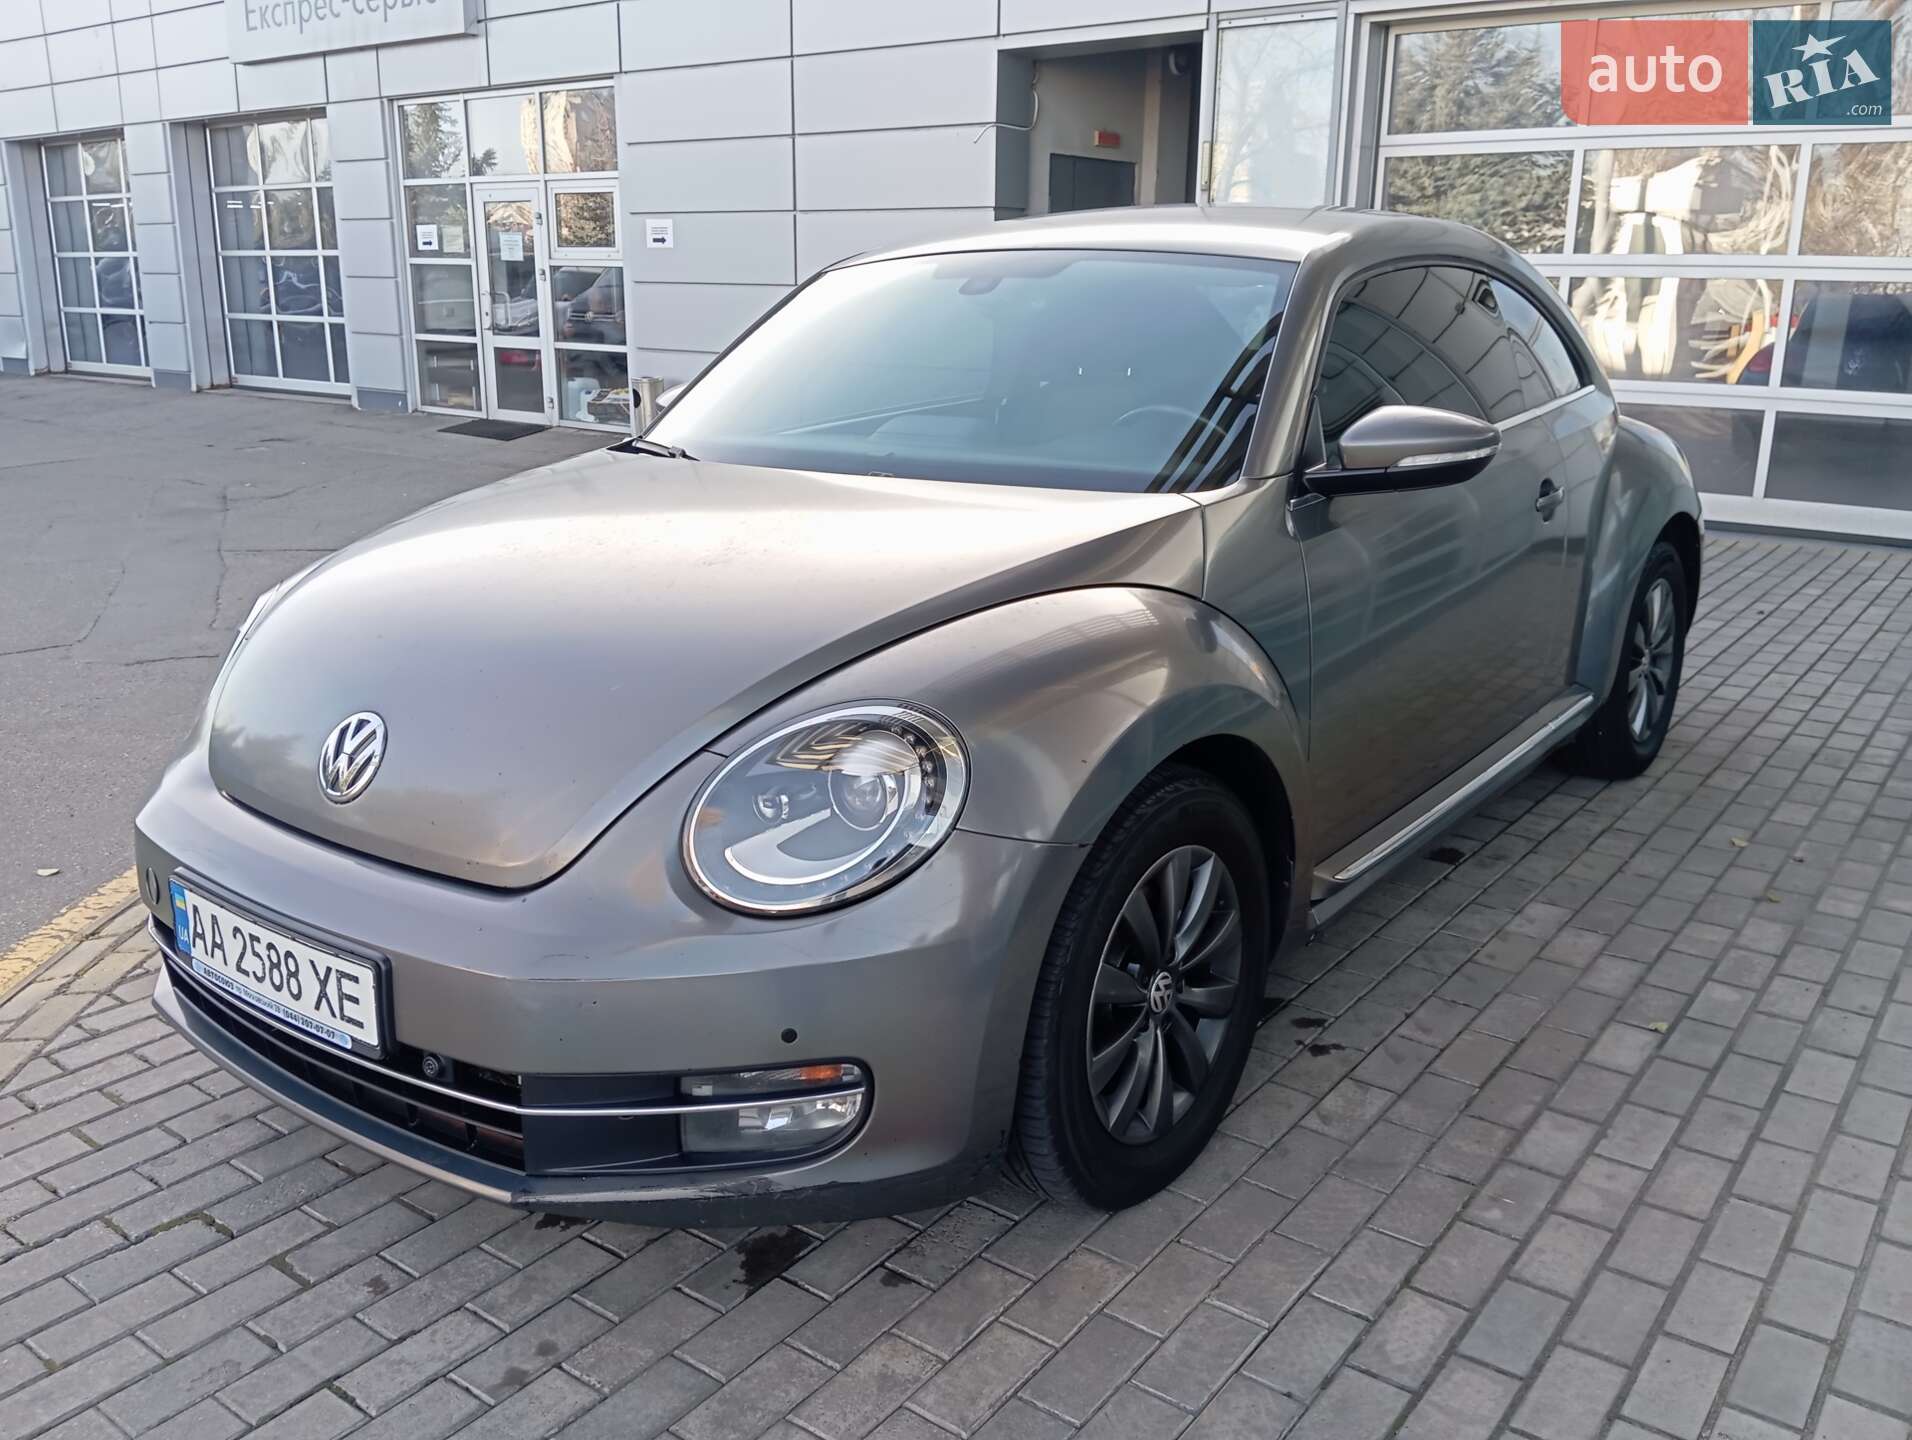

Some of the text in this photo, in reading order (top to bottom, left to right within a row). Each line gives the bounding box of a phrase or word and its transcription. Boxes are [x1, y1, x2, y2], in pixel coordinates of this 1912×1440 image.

[178, 925, 189, 945] UA
[192, 904, 365, 1029] AA 2588 XE
